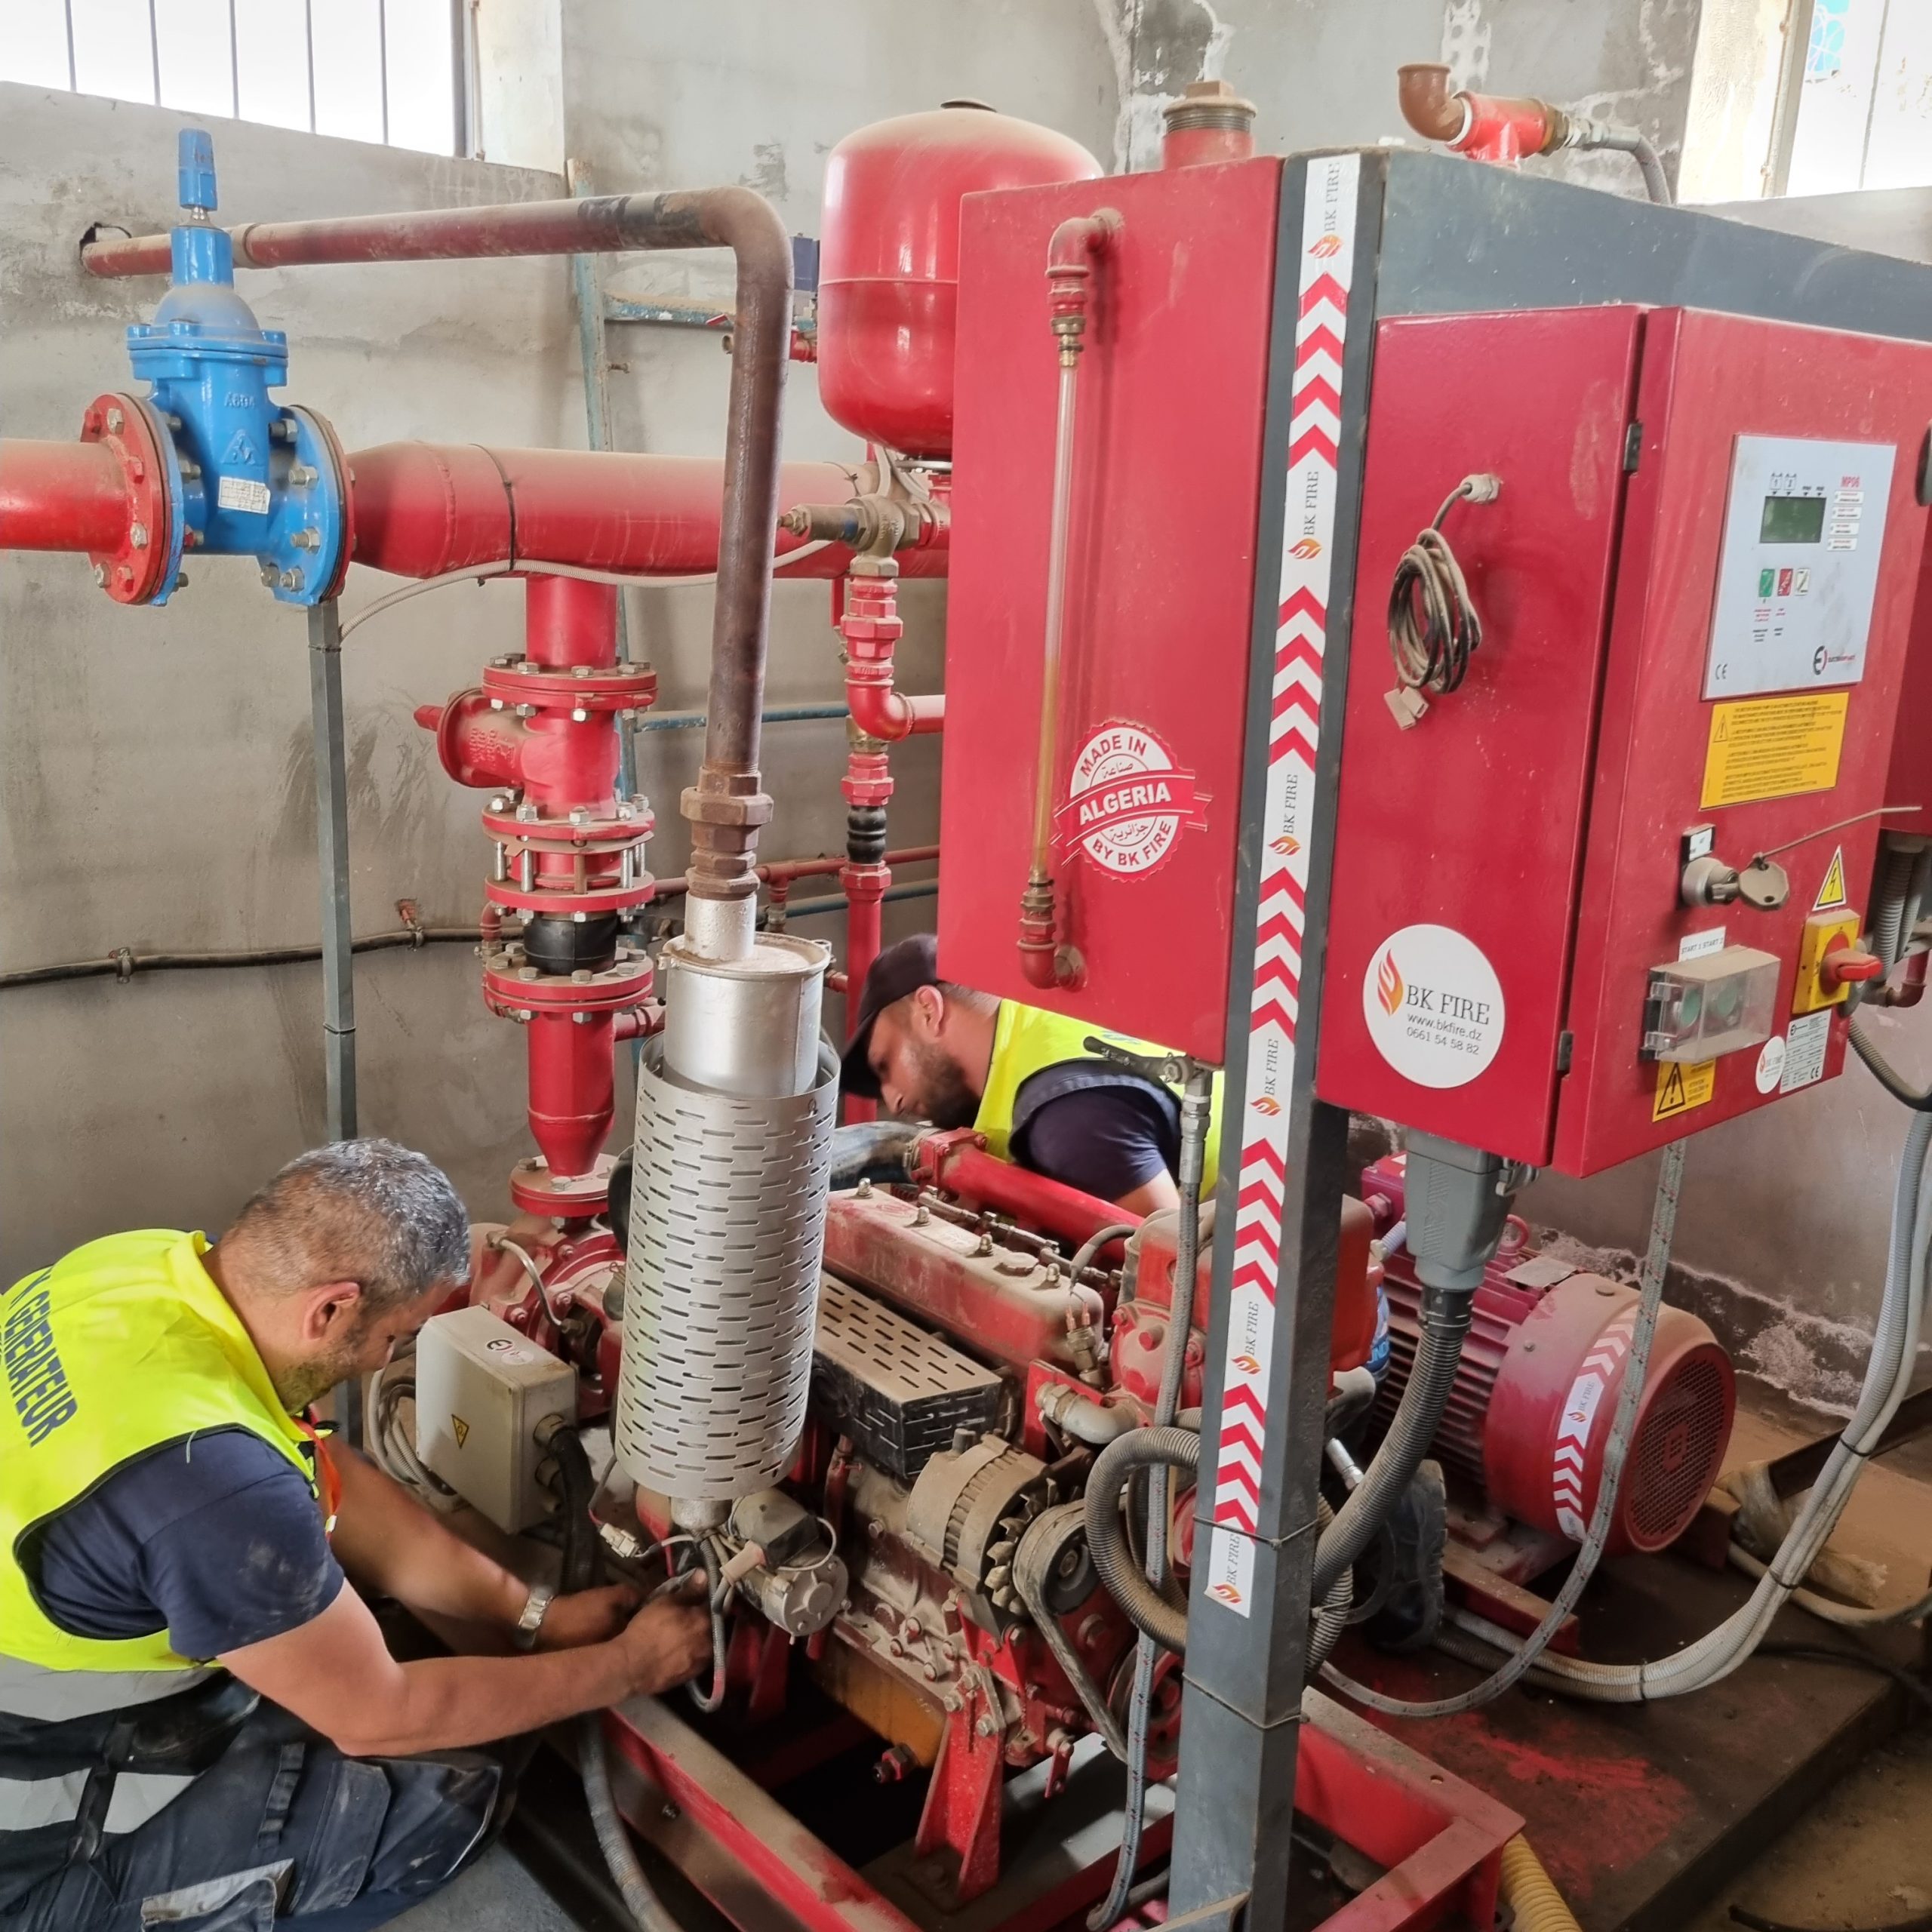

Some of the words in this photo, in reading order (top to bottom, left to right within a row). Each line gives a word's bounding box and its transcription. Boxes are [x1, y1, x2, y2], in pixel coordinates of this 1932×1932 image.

[1326, 163, 1340, 203] FIRE
[1324, 210, 1337, 232] BK
[1306, 471, 1318, 509] FIRE
[1304, 515, 1315, 535] BK
[1080, 734, 1122, 777] MADE
[1128, 736, 1146, 756] IN
[1079, 782, 1172, 826] ALGERIA
[1285, 774, 1298, 809] FIRE
[1283, 814, 1295, 834] BK
[1092, 838, 1114, 860] BY
[1118, 851, 1140, 866] BK
[1142, 820, 1171, 860] FIRE
[1406, 984, 1434, 1011] BK
[1440, 992, 1491, 1025] FIRE
[1407, 1013, 1483, 1041] www.bkfire.dz
[1407, 1026, 1431, 1042] 0661
[1434, 1035, 1447, 1047] 54
[1451, 1038, 1463, 1051] 58
[1466, 1042, 1480, 1055] 82
[1266, 1038, 1279, 1072] FIRE
[1265, 1076, 1276, 1096] BK
[1247, 1301, 1259, 1334] FIRE
[1245, 1336, 1257, 1355] BK
[5, 1290, 78, 1448] GENERATEUR
[1228, 1534, 1241, 1565] FIRE
[1226, 1565, 1237, 1585] BK
